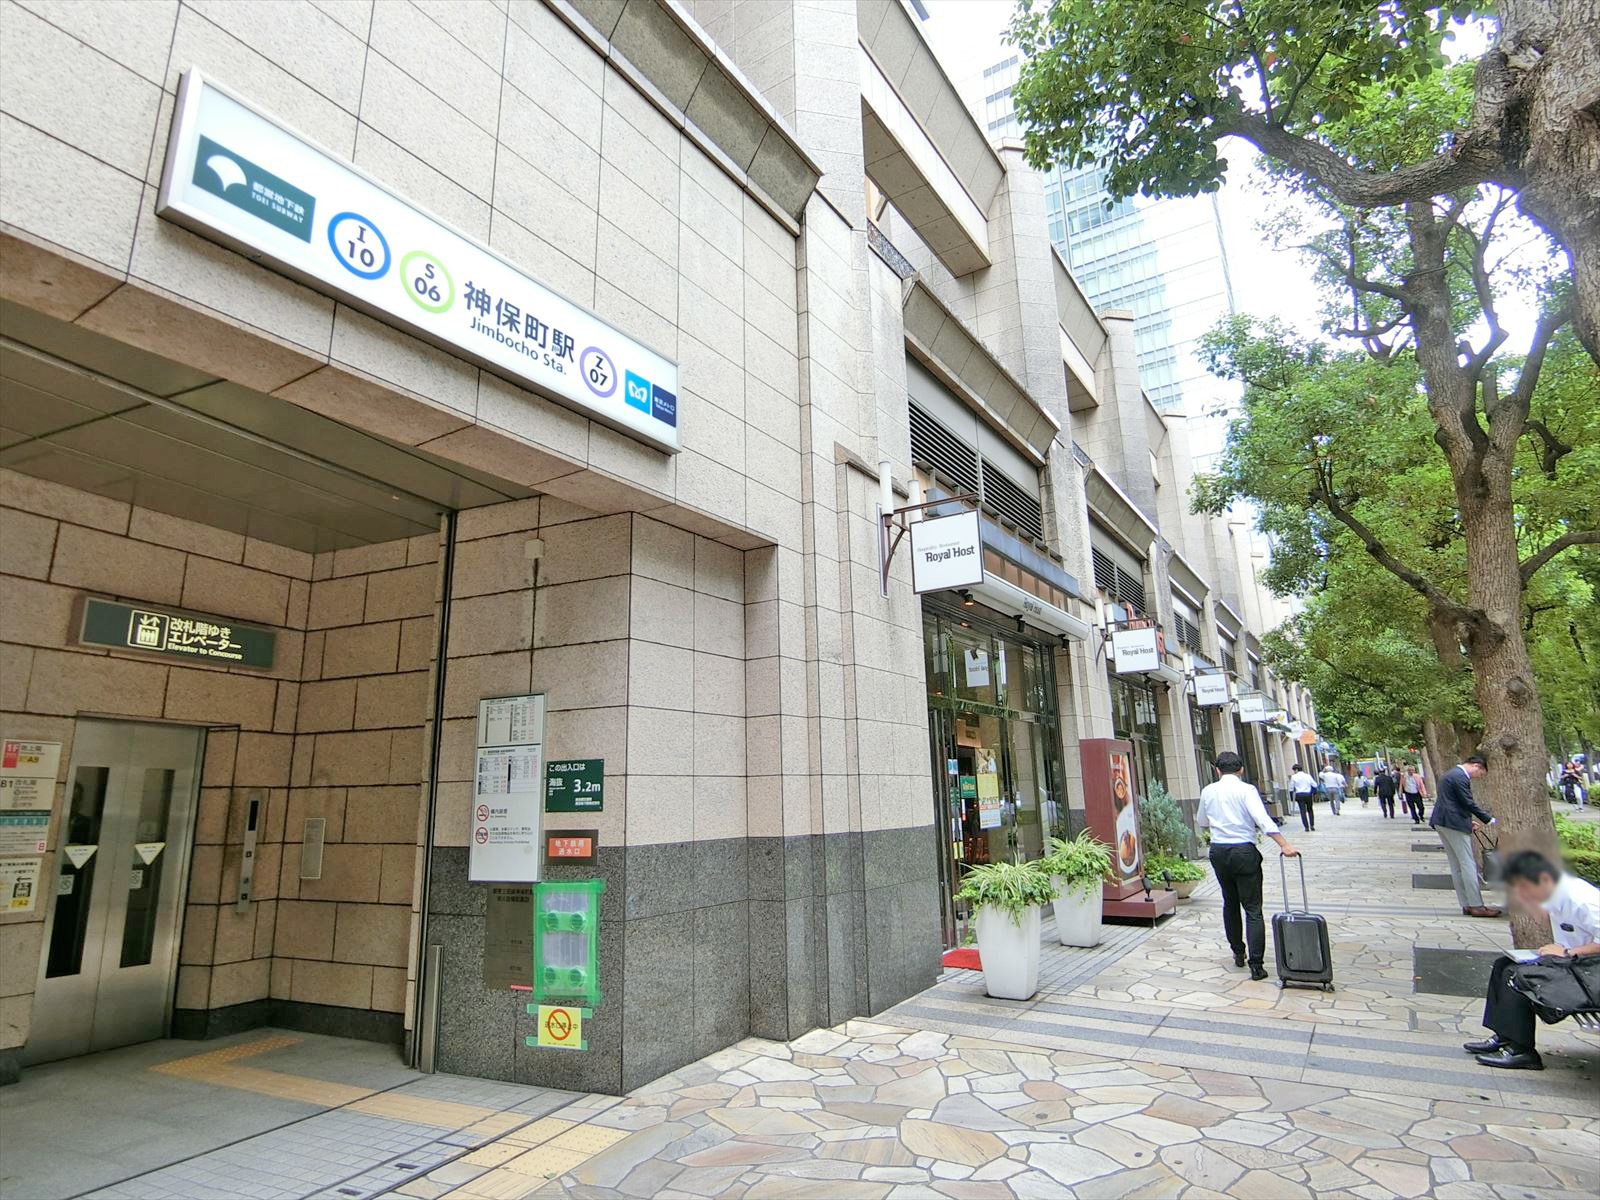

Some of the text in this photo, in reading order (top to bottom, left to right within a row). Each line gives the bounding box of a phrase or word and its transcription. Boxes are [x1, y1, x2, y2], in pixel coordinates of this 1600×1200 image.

[252, 181, 304, 217] 都営地下鉄
[252, 190, 304, 223] TOEI SUBWAY
[348, 240, 374, 267] 10
[425, 263, 435, 279] S
[414, 276, 441, 302] 06
[464, 281, 575, 363] 神保町駅
[470, 317, 567, 376] Jimbocho Sta.
[595, 355, 603, 370] Z
[589, 369, 608, 387] 07
[925, 545, 975, 563] Royal Host
[170, 617, 231, 639] 改札階ゆき
[168, 631, 242, 650] エレベーター
[167, 642, 243, 660] Elevator to Concourse
[548, 763, 586, 772] この出入口は
[573, 779, 601, 793] 3.2m
